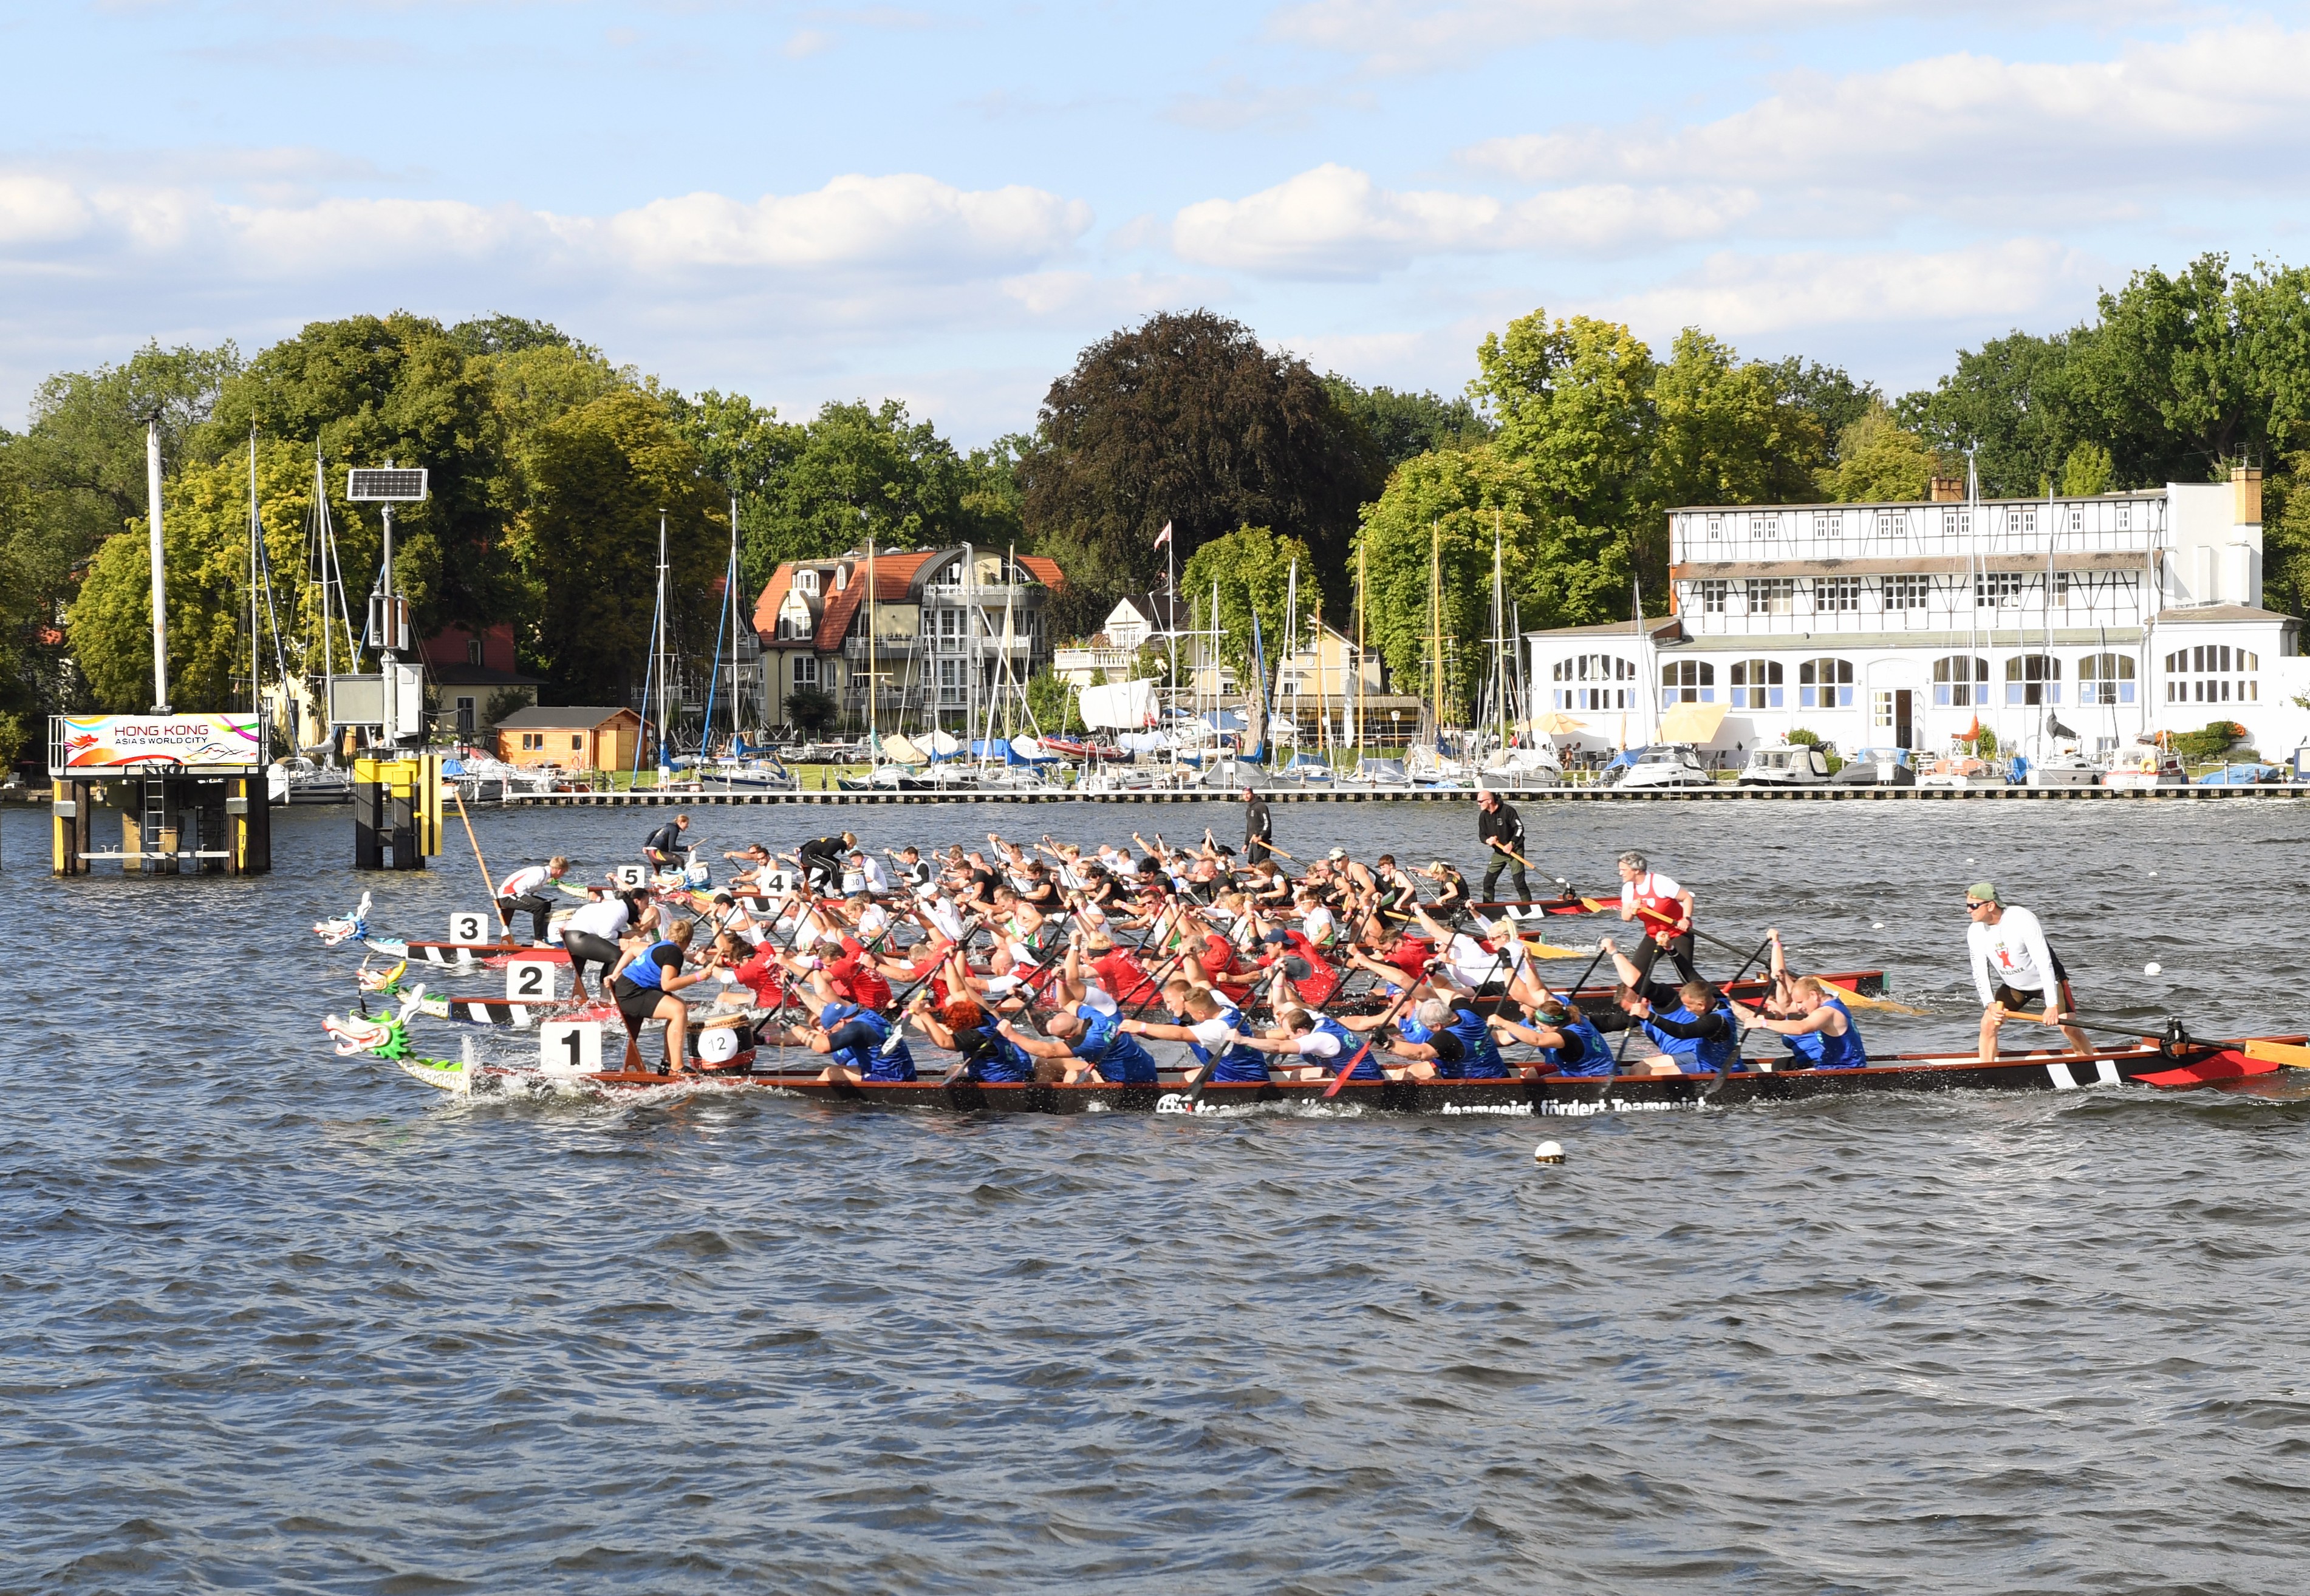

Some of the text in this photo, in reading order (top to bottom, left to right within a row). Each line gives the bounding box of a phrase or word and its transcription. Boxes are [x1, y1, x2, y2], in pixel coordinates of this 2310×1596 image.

[115, 725, 208, 737] HONG KONG
[624, 869, 638, 885] 5
[693, 870, 705, 881] 14
[768, 875, 784, 892] 4
[460, 917, 478, 940] 3
[518, 966, 542, 995] 2
[561, 1029, 580, 1066] 1
[708, 1037, 726, 1051] 12
[1540, 1099, 1607, 1116] fördert
